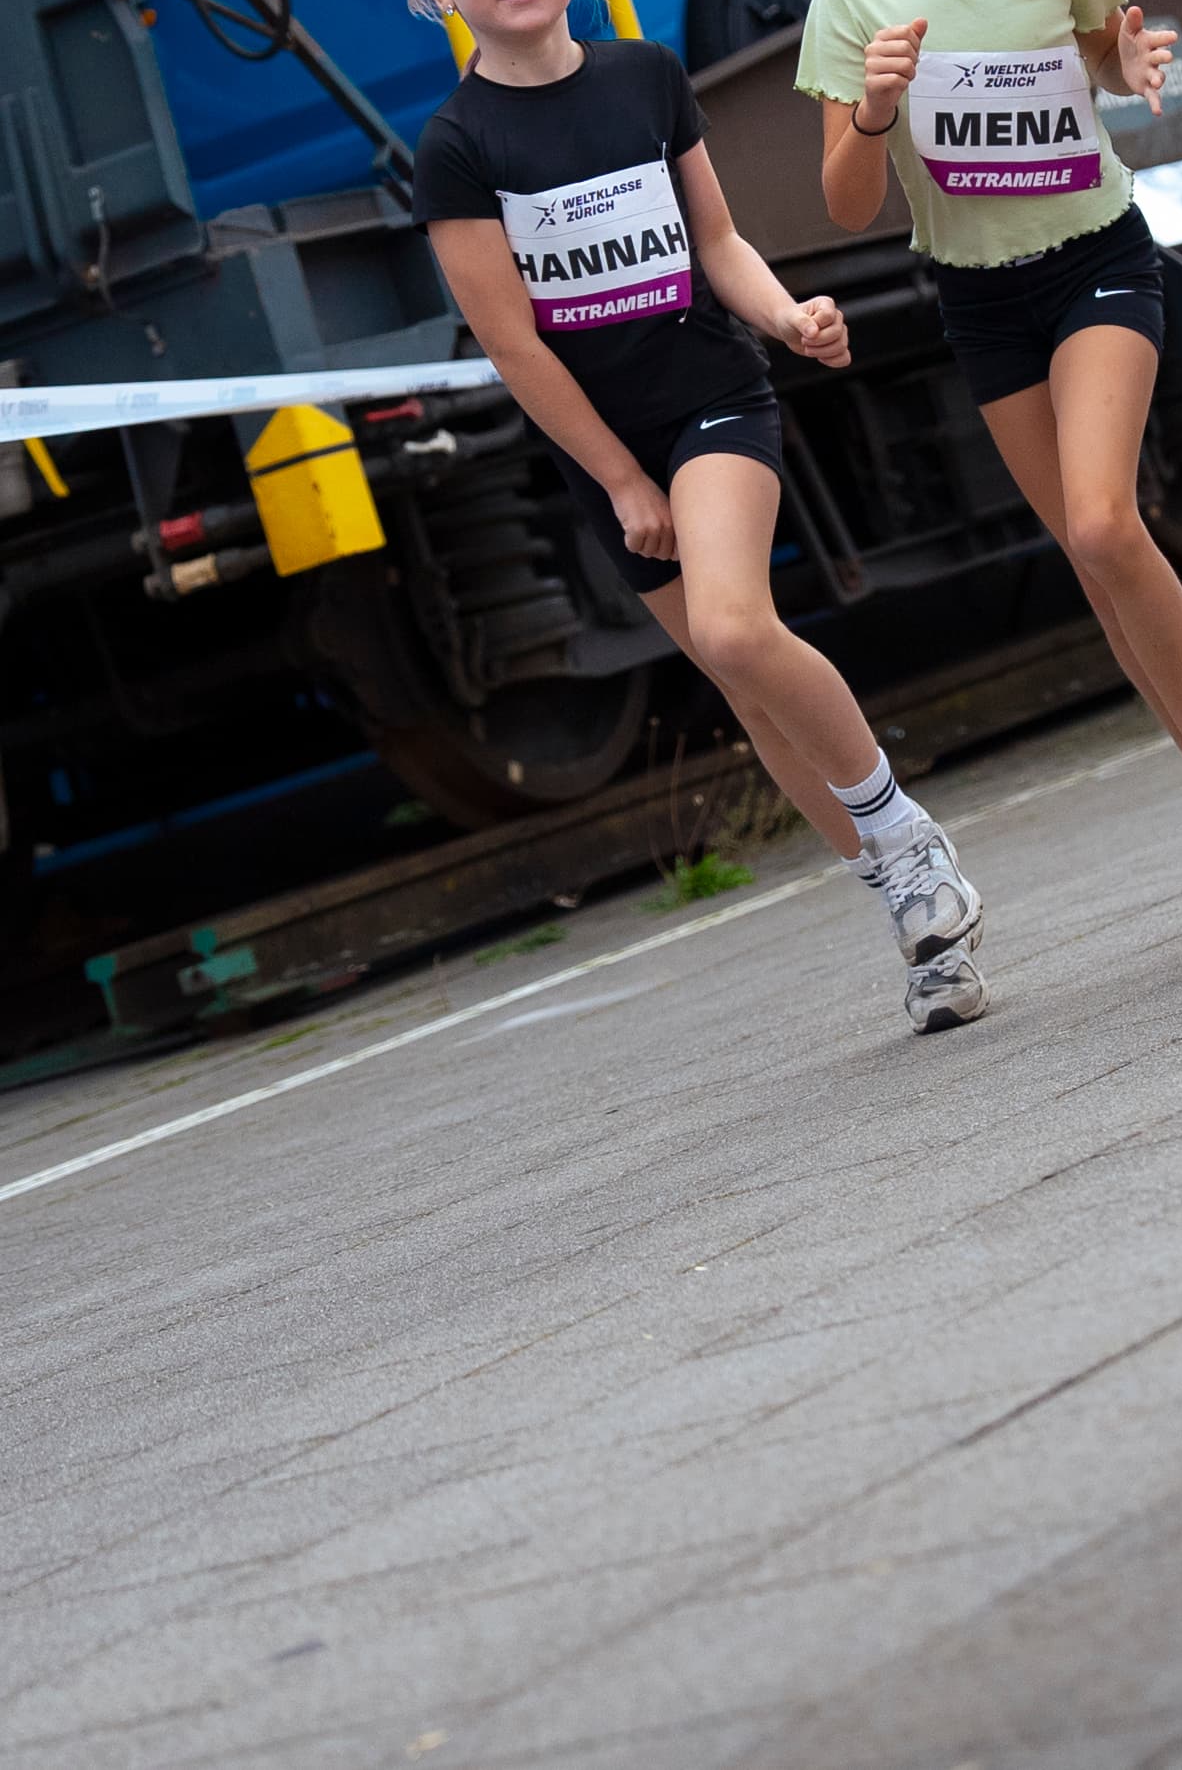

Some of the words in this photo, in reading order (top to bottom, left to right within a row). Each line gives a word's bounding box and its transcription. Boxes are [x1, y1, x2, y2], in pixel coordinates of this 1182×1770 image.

[984, 59, 1063, 76] WELTKLASSE
[984, 76, 1036, 88] ZÜRICH
[935, 107, 1082, 146] MENA
[946, 169, 1073, 188] EXTRAMEILE
[562, 179, 643, 210] WELTKLASSE
[566, 200, 615, 222] ZÜRICH
[513, 222, 688, 283] HANNAH
[552, 285, 679, 324] EXTRAMEILE
